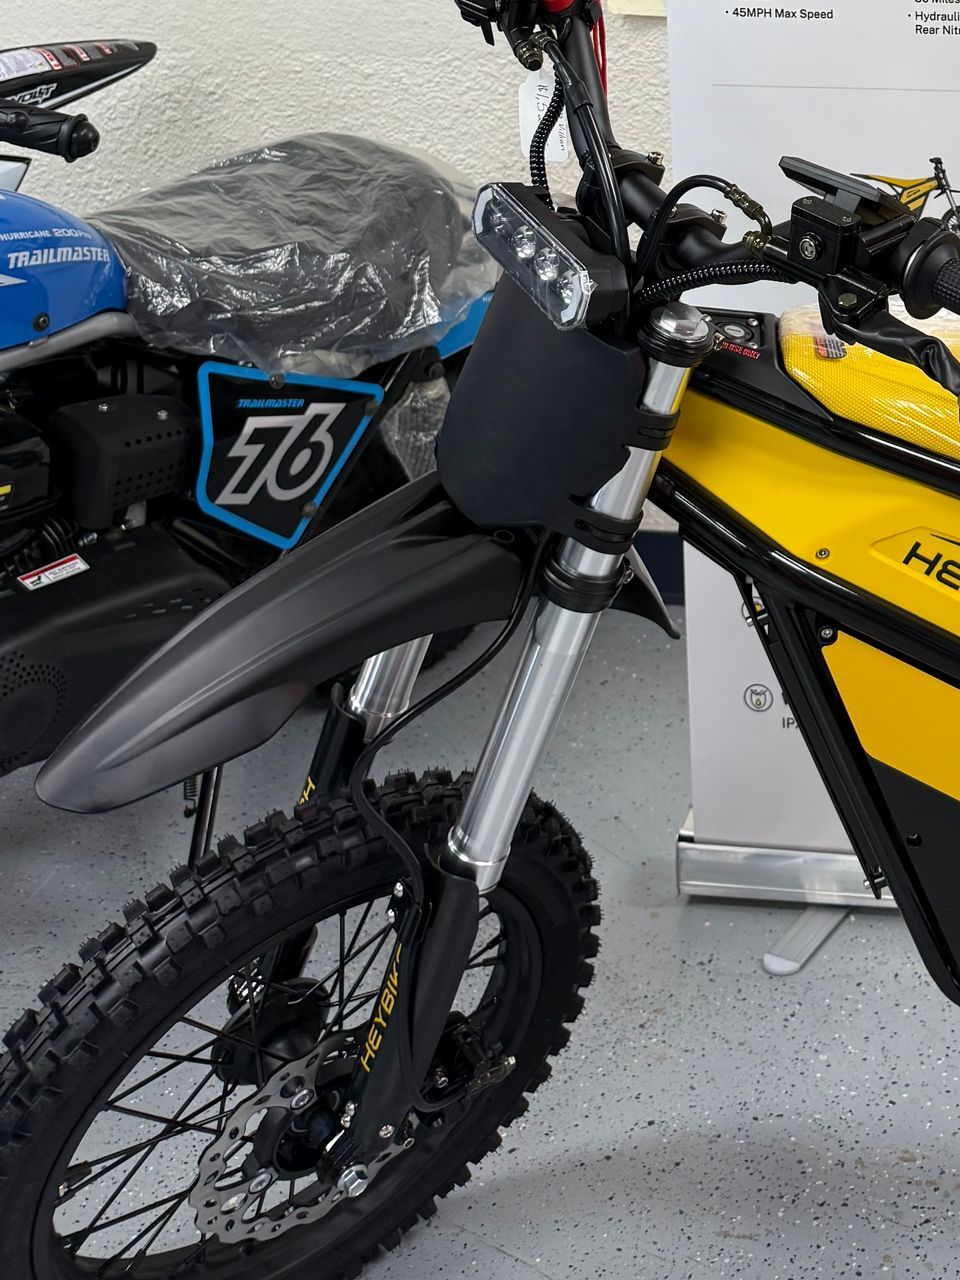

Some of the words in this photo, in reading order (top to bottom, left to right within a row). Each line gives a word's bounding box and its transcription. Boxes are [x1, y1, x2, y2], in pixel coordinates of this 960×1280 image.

[732, 8, 772, 19] 45MPH
[774, 8, 798, 20] Max
[799, 9, 834, 22] Speed
[915, 25, 940, 36] Rear
[0, 229, 51, 241] HURRICANE
[8, 246, 111, 269] TRAILMASTER
[236, 398, 305, 409] TRAILMASTER
[215, 402, 347, 505] 76
